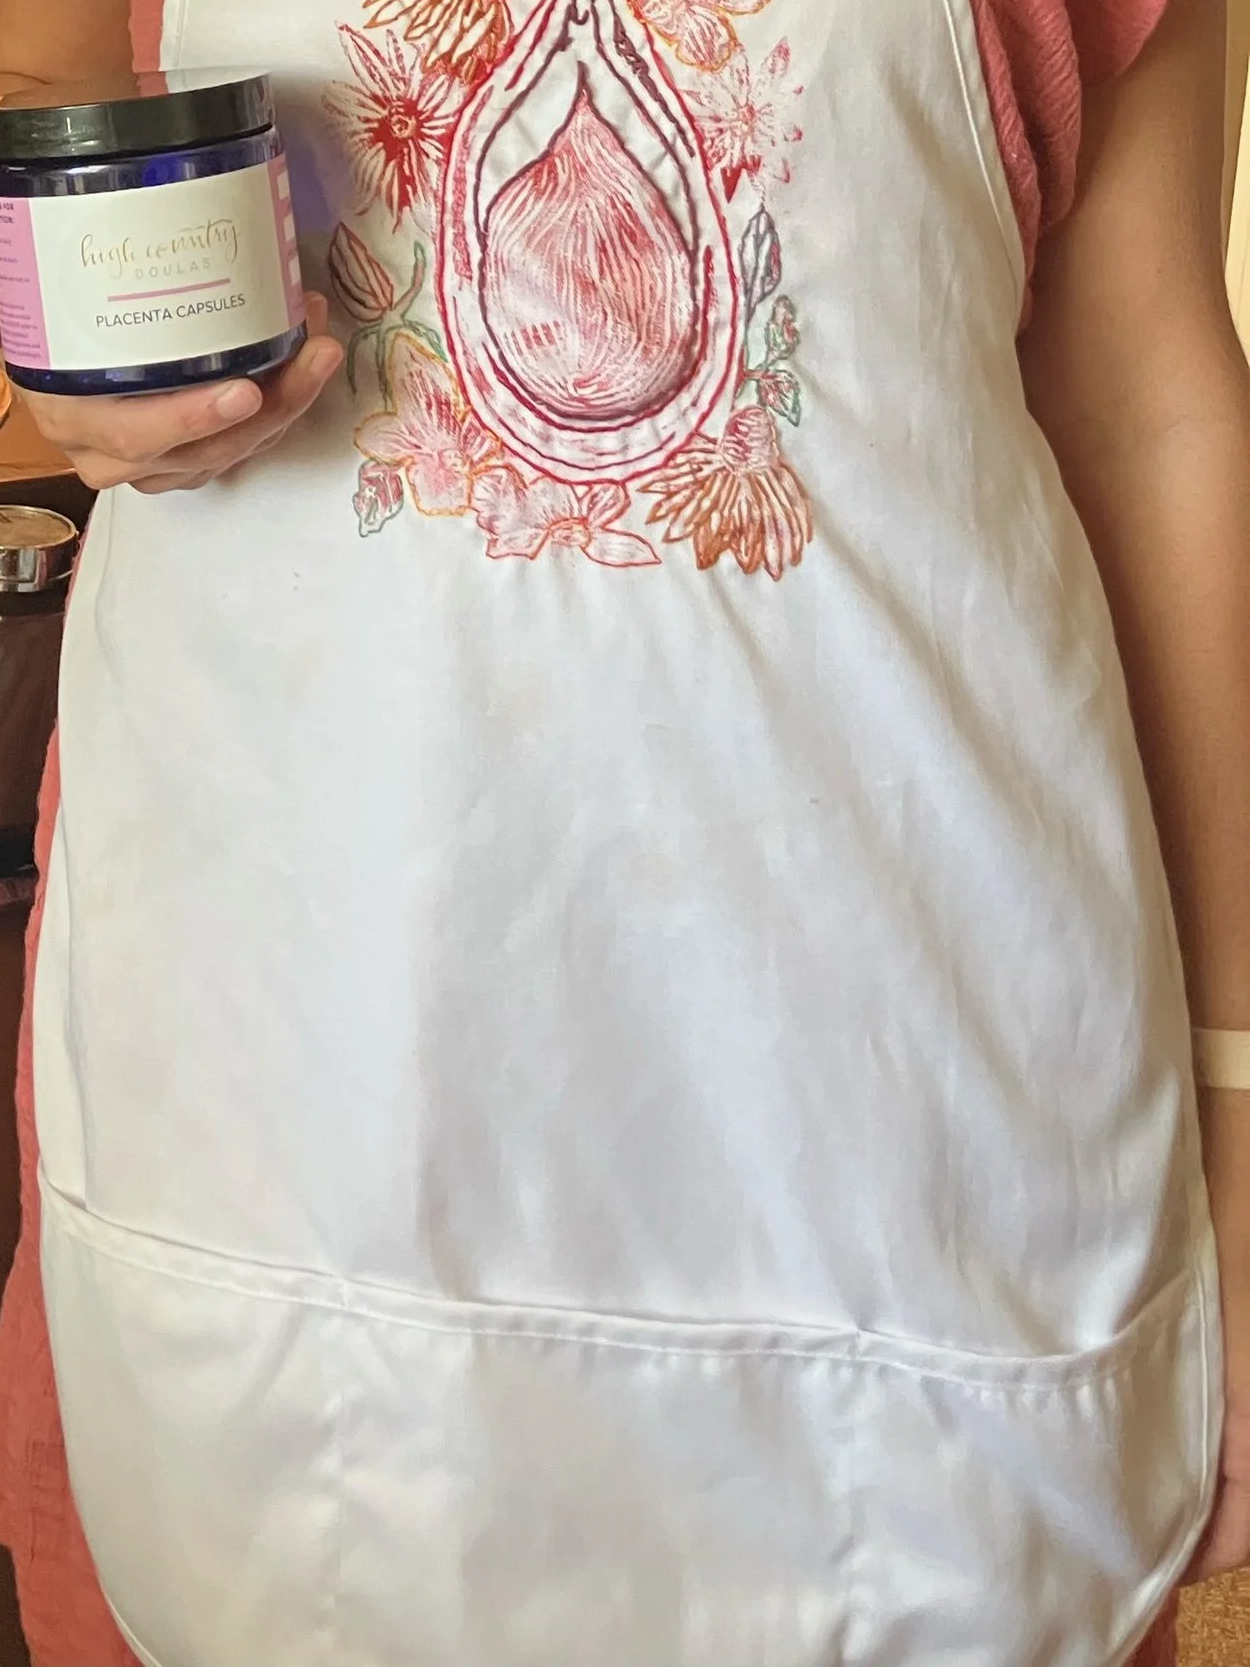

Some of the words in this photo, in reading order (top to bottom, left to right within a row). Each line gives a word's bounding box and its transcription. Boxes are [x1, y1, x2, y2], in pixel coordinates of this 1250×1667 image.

[81, 233, 135, 280] high
[146, 218, 240, 264] country
[134, 257, 211, 280] DOULAS
[95, 307, 173, 328] PLACENTA
[176, 293, 246, 318] CAPSULES
